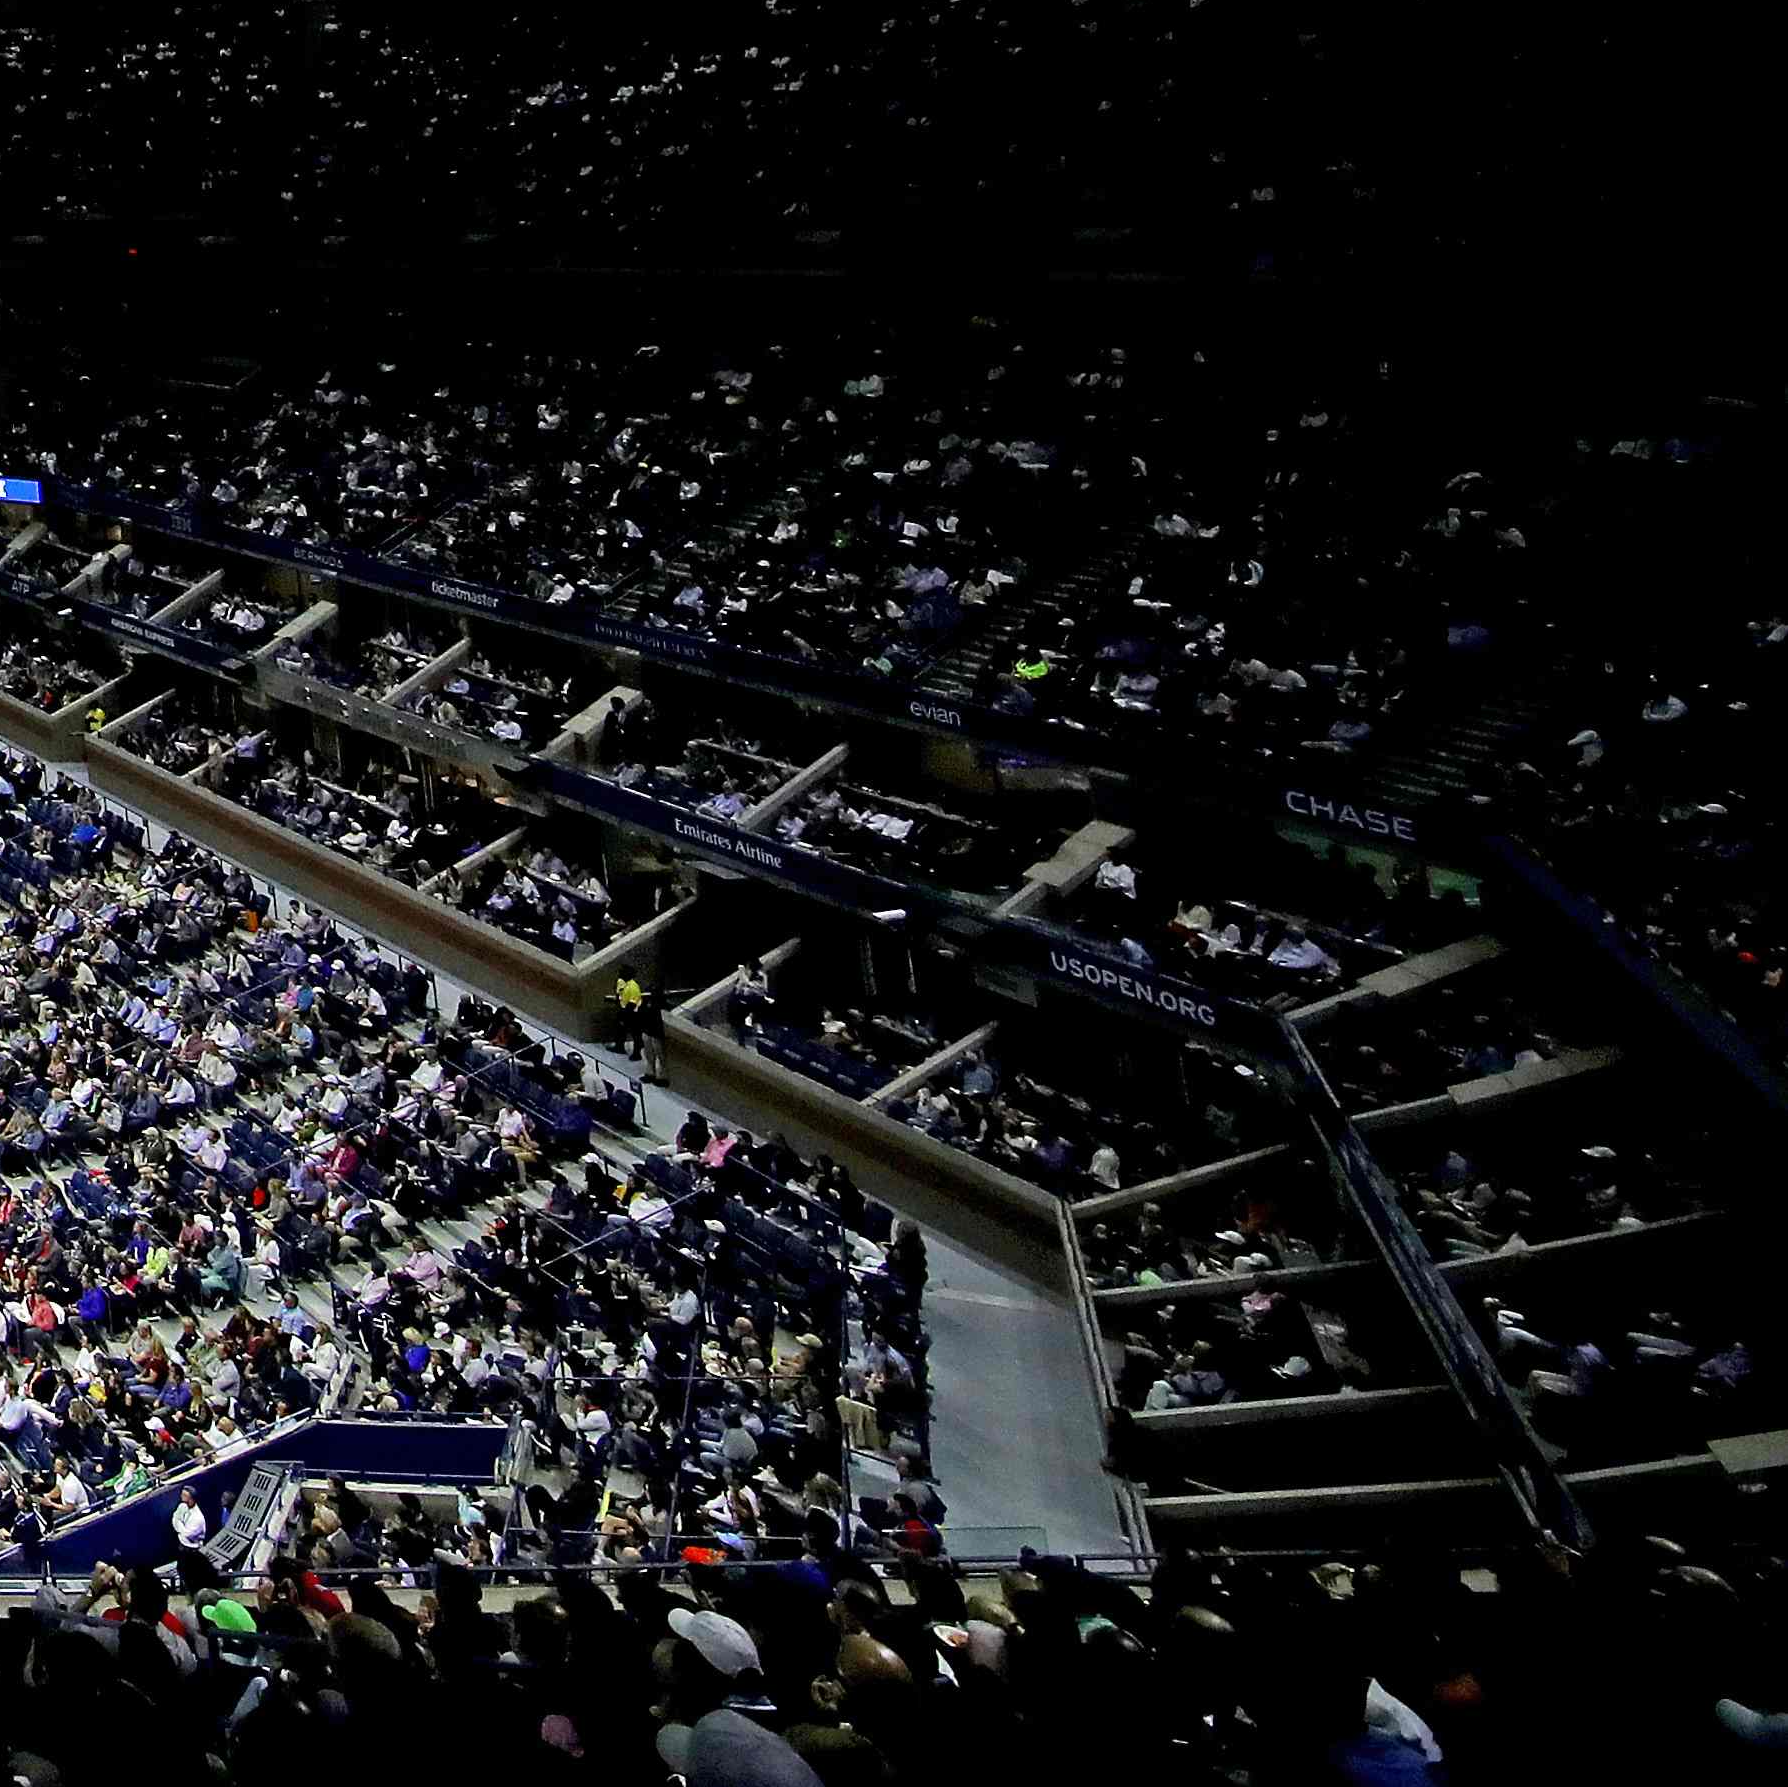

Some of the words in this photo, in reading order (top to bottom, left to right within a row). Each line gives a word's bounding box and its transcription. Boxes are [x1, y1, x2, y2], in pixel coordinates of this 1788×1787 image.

[910, 701, 962, 727] evian
[1285, 790, 1418, 842] CHASE
[674, 817, 732, 850] Emirates
[735, 840, 783, 868] Airline
[1050, 951, 1216, 1026] USOPEN.ORG
